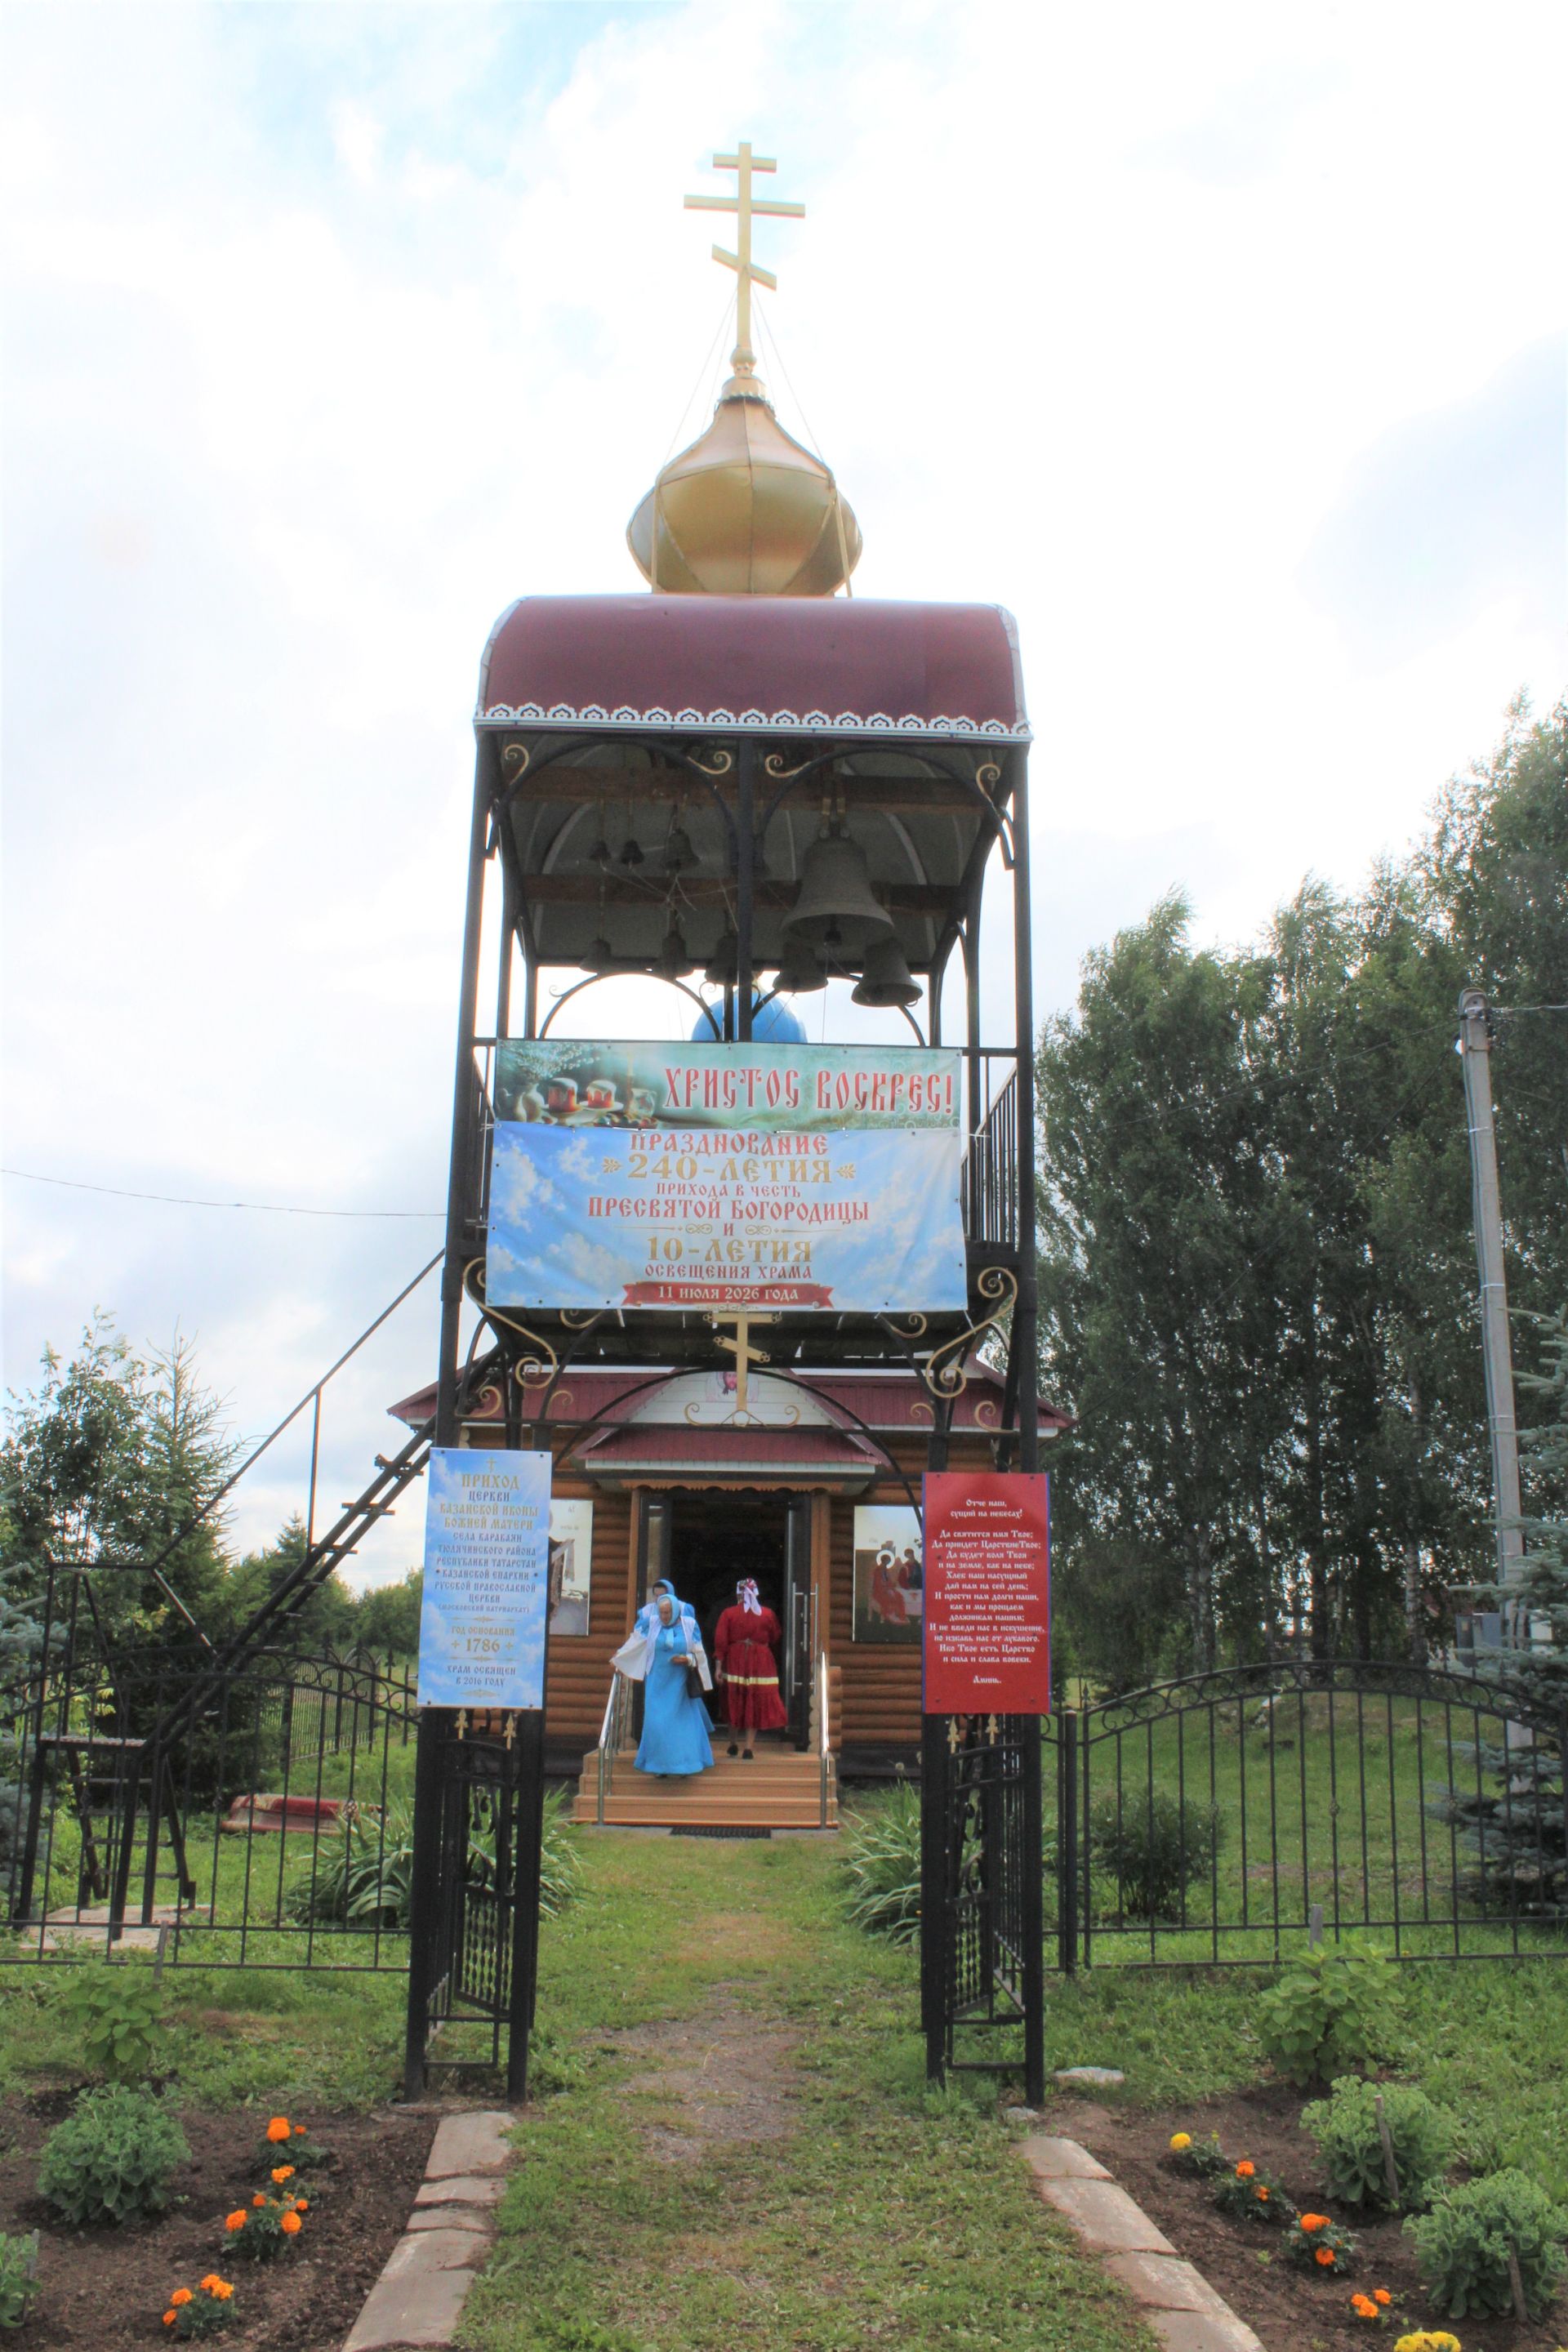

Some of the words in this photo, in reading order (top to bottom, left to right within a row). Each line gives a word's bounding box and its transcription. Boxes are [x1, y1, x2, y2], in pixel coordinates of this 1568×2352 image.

[663, 1067, 800, 1110] ХРИСТОС
[816, 1069, 953, 1115] ВОСКРЕС!
[630, 1132, 830, 1156] ПРАЗДНОВАНИЕ
[628, 1153, 833, 1183] 240-ЛЕТИЯ
[657, 1180, 730, 1199] ПРИХОДА
[735, 1183, 745, 1197] В
[751, 1183, 801, 1199] ЧЕСТЬ
[588, 1194, 722, 1220] ПРЕСВЯТОЙ
[731, 1197, 870, 1227] БОГОРОДИЦЫ
[723, 1222, 734, 1236] И
[647, 1236, 813, 1263] 10-ЛЕТИЯ
[644, 1262, 751, 1280] ОСВЕЩЕНИЯ
[757, 1263, 813, 1281] ХРАМА
[657, 1285, 673, 1298] 11
[679, 1287, 719, 1300] июля
[725, 1287, 760, 1300] 2026
[765, 1288, 799, 1301] года
[462, 1474, 519, 1490] ПРИХОД
[469, 1490, 510, 1503] ЦЕРКВИ
[966, 1499, 986, 1507] Отче
[440, 1503, 498, 1516] КАЗАНСКОЙ
[503, 1505, 538, 1517] ИКОНЫ
[951, 1510, 975, 1519] сущий
[991, 1509, 1023, 1519] небесах!
[445, 1517, 487, 1529] БОЖИЕЙ
[491, 1519, 532, 1530] МАТЕРИ
[453, 1532, 475, 1540] СЕЛА
[940, 1530, 951, 1538] Да
[438, 1544, 503, 1555] ТЮЛЯЧИНСКОГО
[506, 1546, 537, 1556] РАЙОНА
[932, 1540, 942, 1548] Да
[947, 1551, 957, 1559] Да
[960, 1552, 984, 1561] будет
[1007, 1551, 1027, 1559] Твоя
[437, 1557, 488, 1567] РЕСПУБЛИКИ
[492, 1558, 537, 1568] ТАТАРСТАН
[443, 1569, 489, 1579] КАЗАНСКОЙ
[492, 1571, 528, 1579] ЕПАРХИИ
[987, 1572, 1027, 1581] насущный
[434, 1580, 470, 1592] РУССКОЙ
[474, 1582, 536, 1592] ПРАВОСЛАВНОЙ
[469, 1594, 501, 1603] ЦЕРКВИ
[945, 1593, 971, 1601] прости
[452, 1625, 466, 1635] ГОД
[468, 1626, 515, 1636] ОСНОВАНИЯ
[466, 1638, 501, 1652] 1786
[1001, 1645, 1036, 1653] Царство
[474, 1666, 516, 1676] ОСВЯЩЕН
[464, 1677, 482, 1685] 2016
[485, 1677, 506, 1687] ГОДУ
